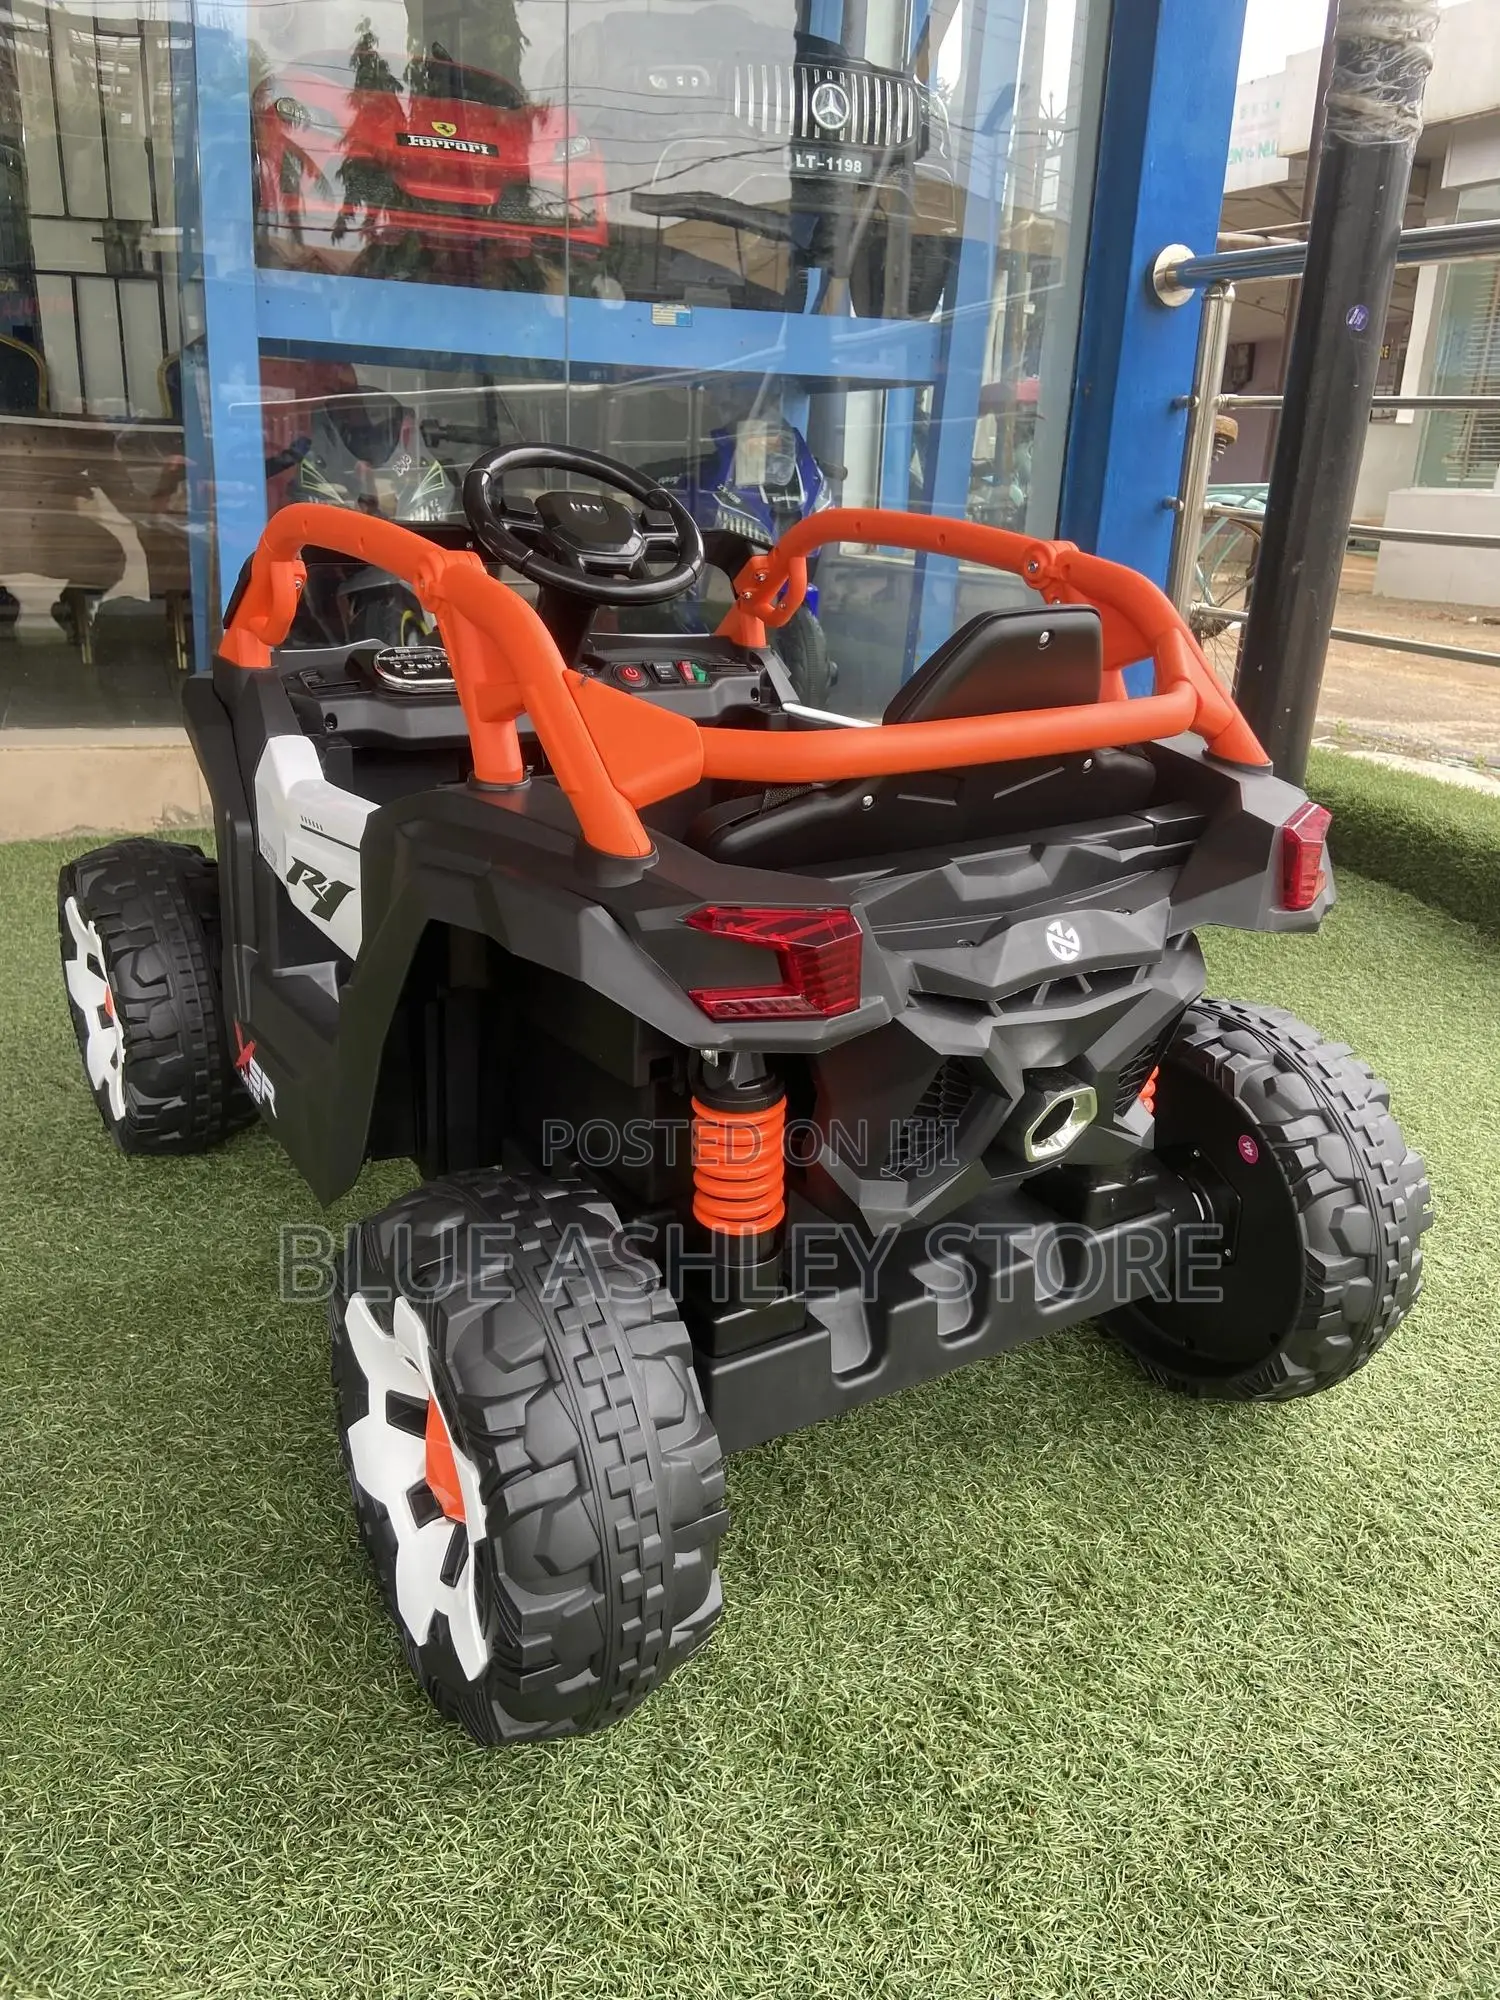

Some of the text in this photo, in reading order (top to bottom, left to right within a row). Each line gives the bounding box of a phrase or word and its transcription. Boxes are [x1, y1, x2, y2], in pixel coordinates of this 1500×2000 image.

[407, 135, 490, 155] Ferrari
[795, 153, 862, 173] LT-1198
[570, 501, 604, 513] UTV
